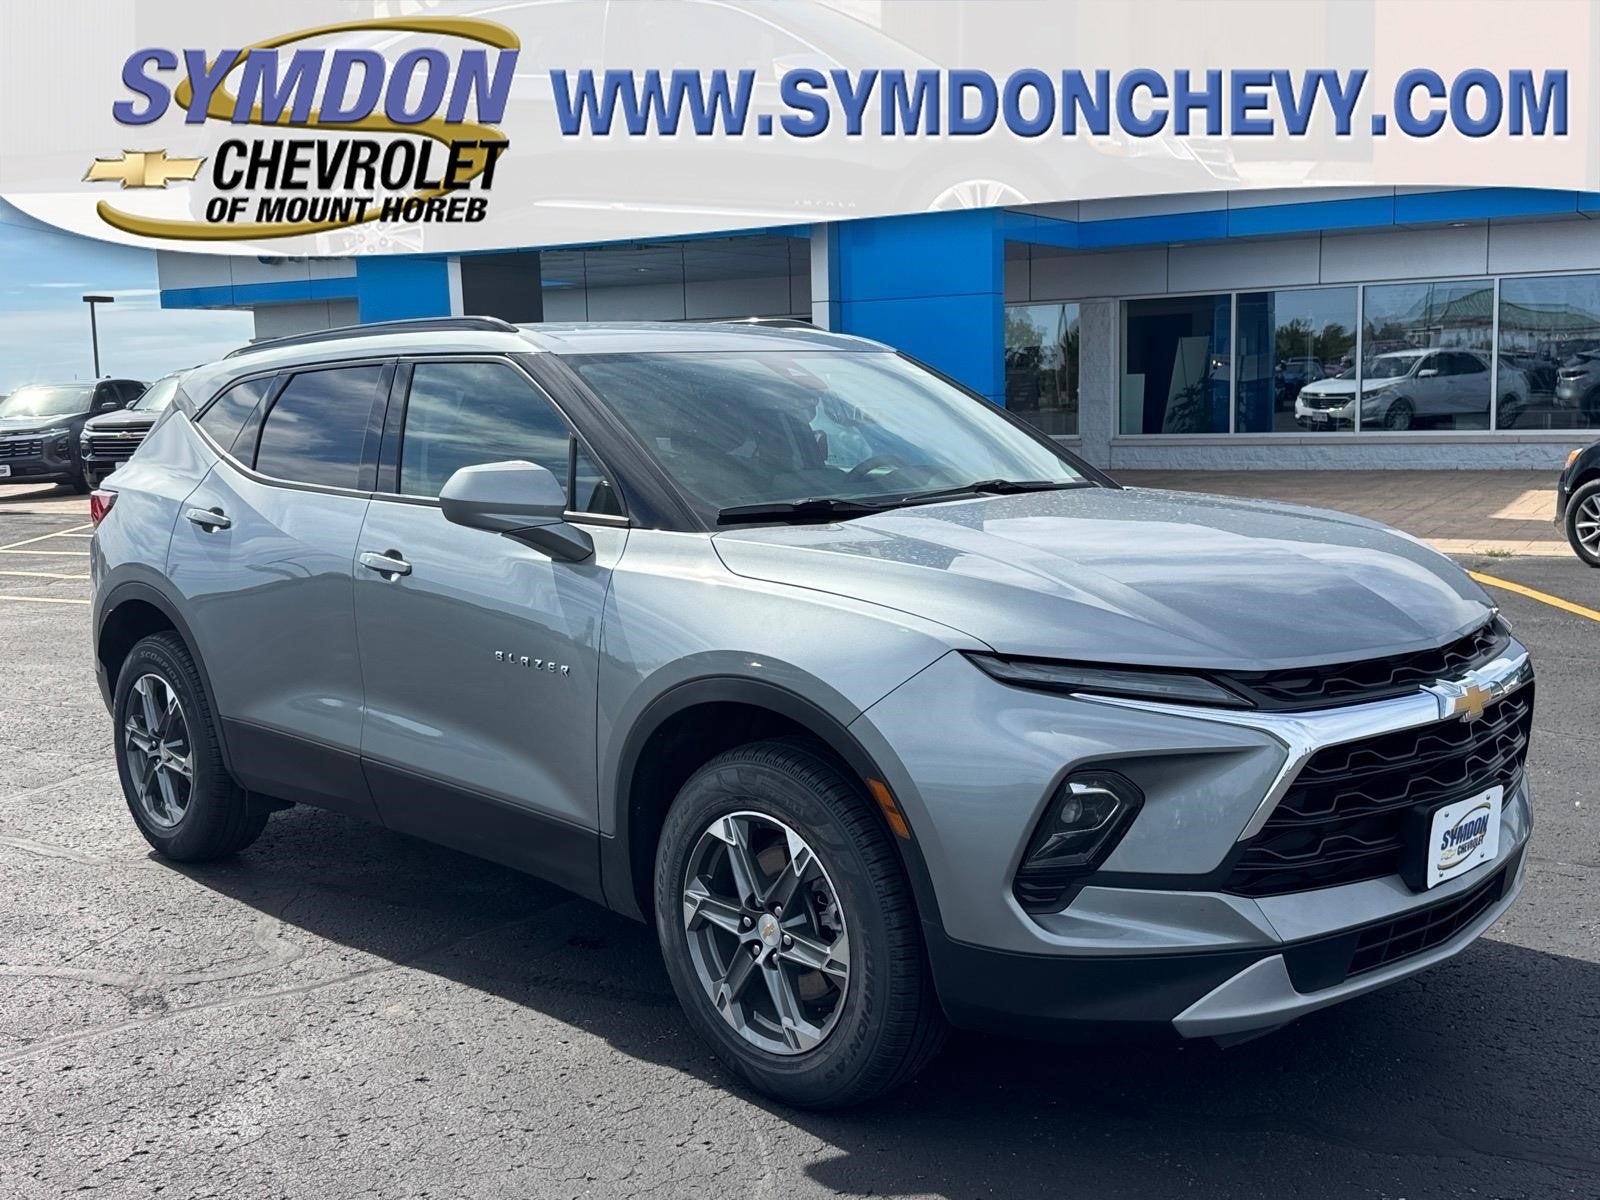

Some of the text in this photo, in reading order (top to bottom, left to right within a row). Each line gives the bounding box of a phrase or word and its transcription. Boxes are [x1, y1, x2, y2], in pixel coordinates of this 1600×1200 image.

[494, 650, 570, 678] BLAZER
[1440, 813, 1490, 850] SYMDON
[1457, 834, 1485, 856] CHEVROLET
